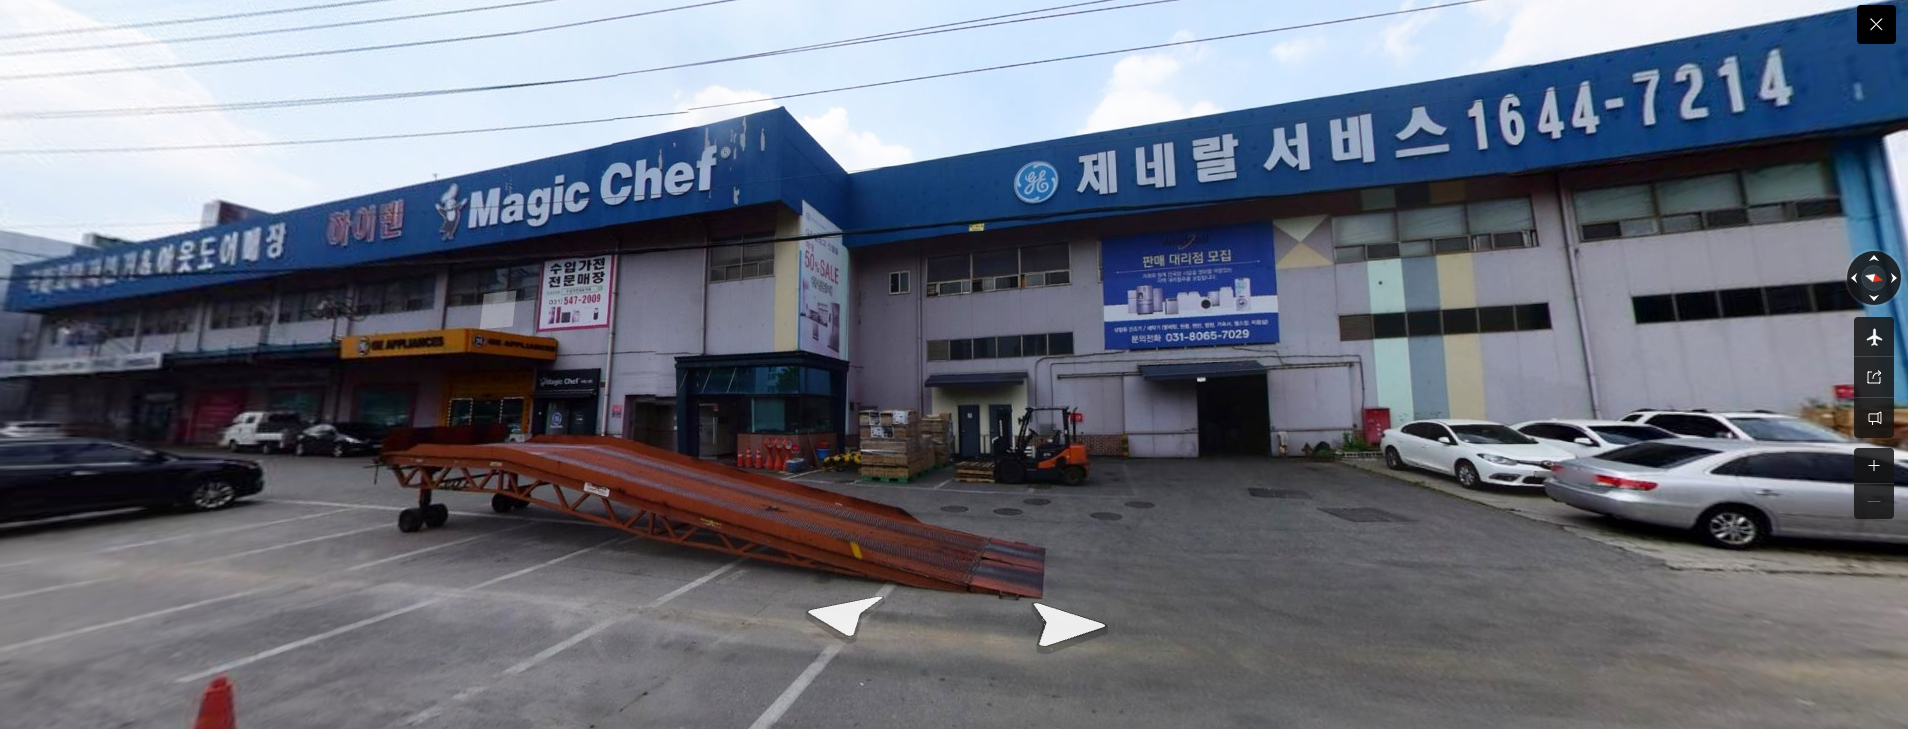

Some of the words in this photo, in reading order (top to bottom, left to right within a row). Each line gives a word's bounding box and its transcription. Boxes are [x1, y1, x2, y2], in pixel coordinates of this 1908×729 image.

[1076, 133, 1239, 195] 제네랄
[1263, 106, 1451, 172] 서비스
[1467, 48, 1794, 151] 1644-7214
[468, 175, 590, 230] Magic
[600, 145, 718, 206] Chef
[550, 257, 605, 274] 수입가전
[1142, 254, 1165, 268] 판매
[1169, 252, 1204, 266] 대리점
[1208, 249, 1232, 263] 모집
[549, 271, 605, 288] 전문매장
[820, 260, 840, 285] SALE
[564, 294, 601, 305] 547-2009
[1131, 334, 1161, 344] 문의전화
[1165, 329, 1250, 342] 031-8065-7029
[563, 377, 579, 385] Chef
